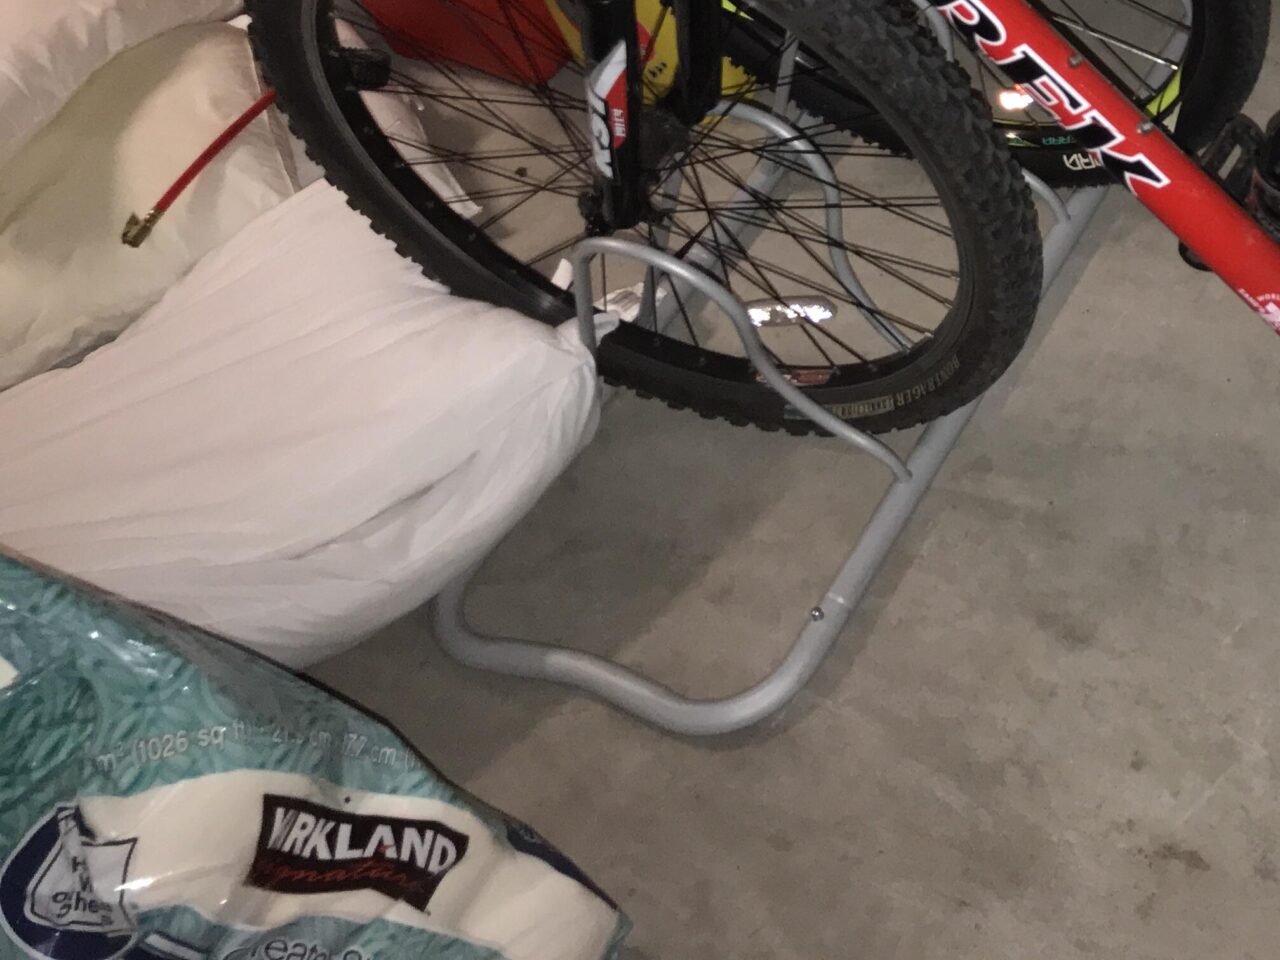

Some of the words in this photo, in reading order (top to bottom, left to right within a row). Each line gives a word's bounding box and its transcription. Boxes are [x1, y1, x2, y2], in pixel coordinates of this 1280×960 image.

[896, 353, 962, 407] BONTRAGER
[133, 729, 190, 769] (1026
[197, 726, 227, 751] sq
